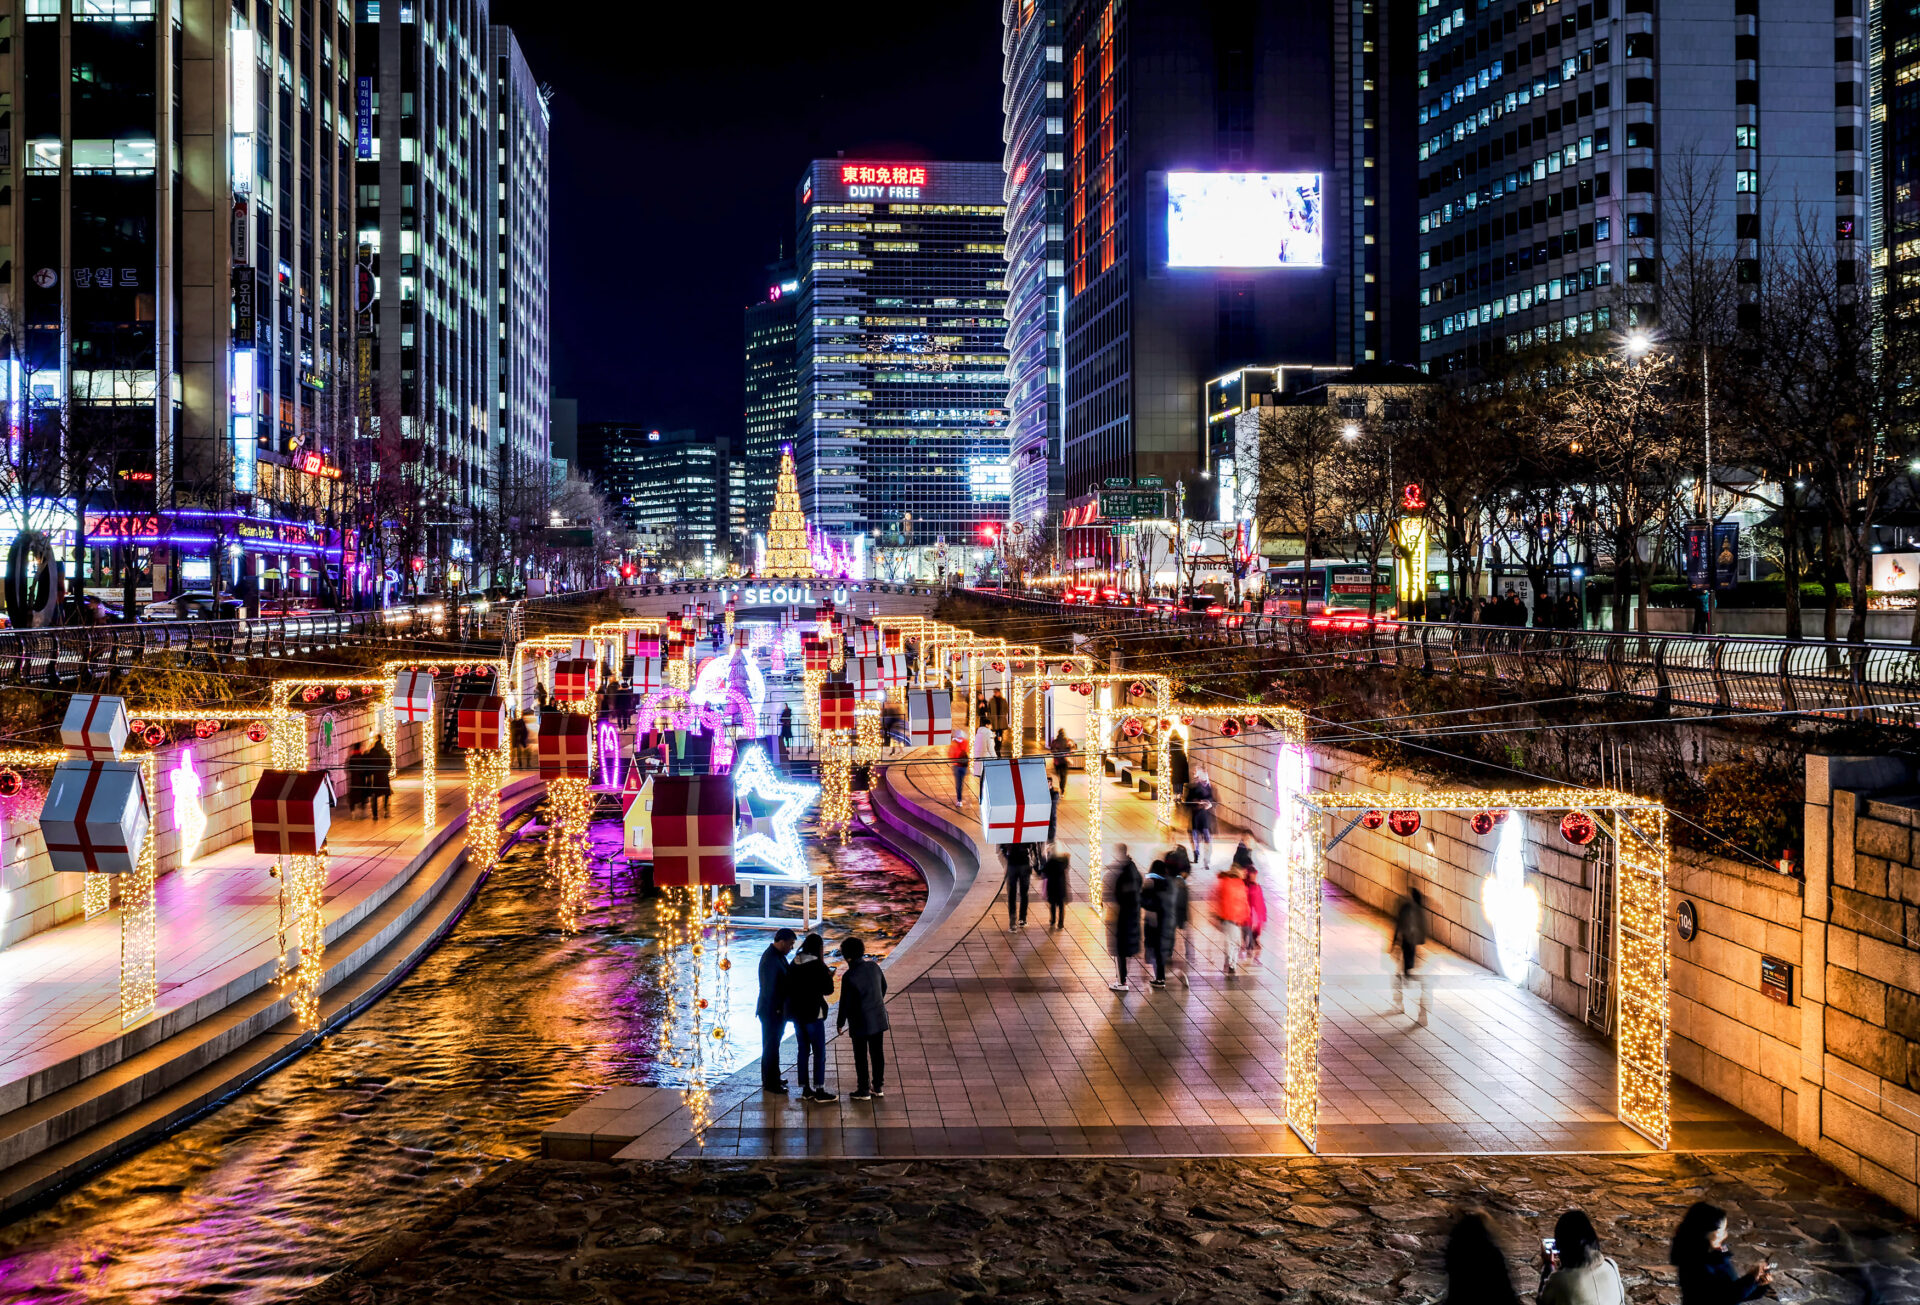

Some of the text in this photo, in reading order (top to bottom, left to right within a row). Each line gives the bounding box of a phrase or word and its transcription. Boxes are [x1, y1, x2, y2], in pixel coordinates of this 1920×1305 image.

[361, 80, 369, 145] 미래이비인후과
[850, 186, 919, 198] DUTY FREE
[73, 267, 139, 288] 단월드
[745, 586, 815, 604] SEOUL
[833, 588, 847, 605] U
